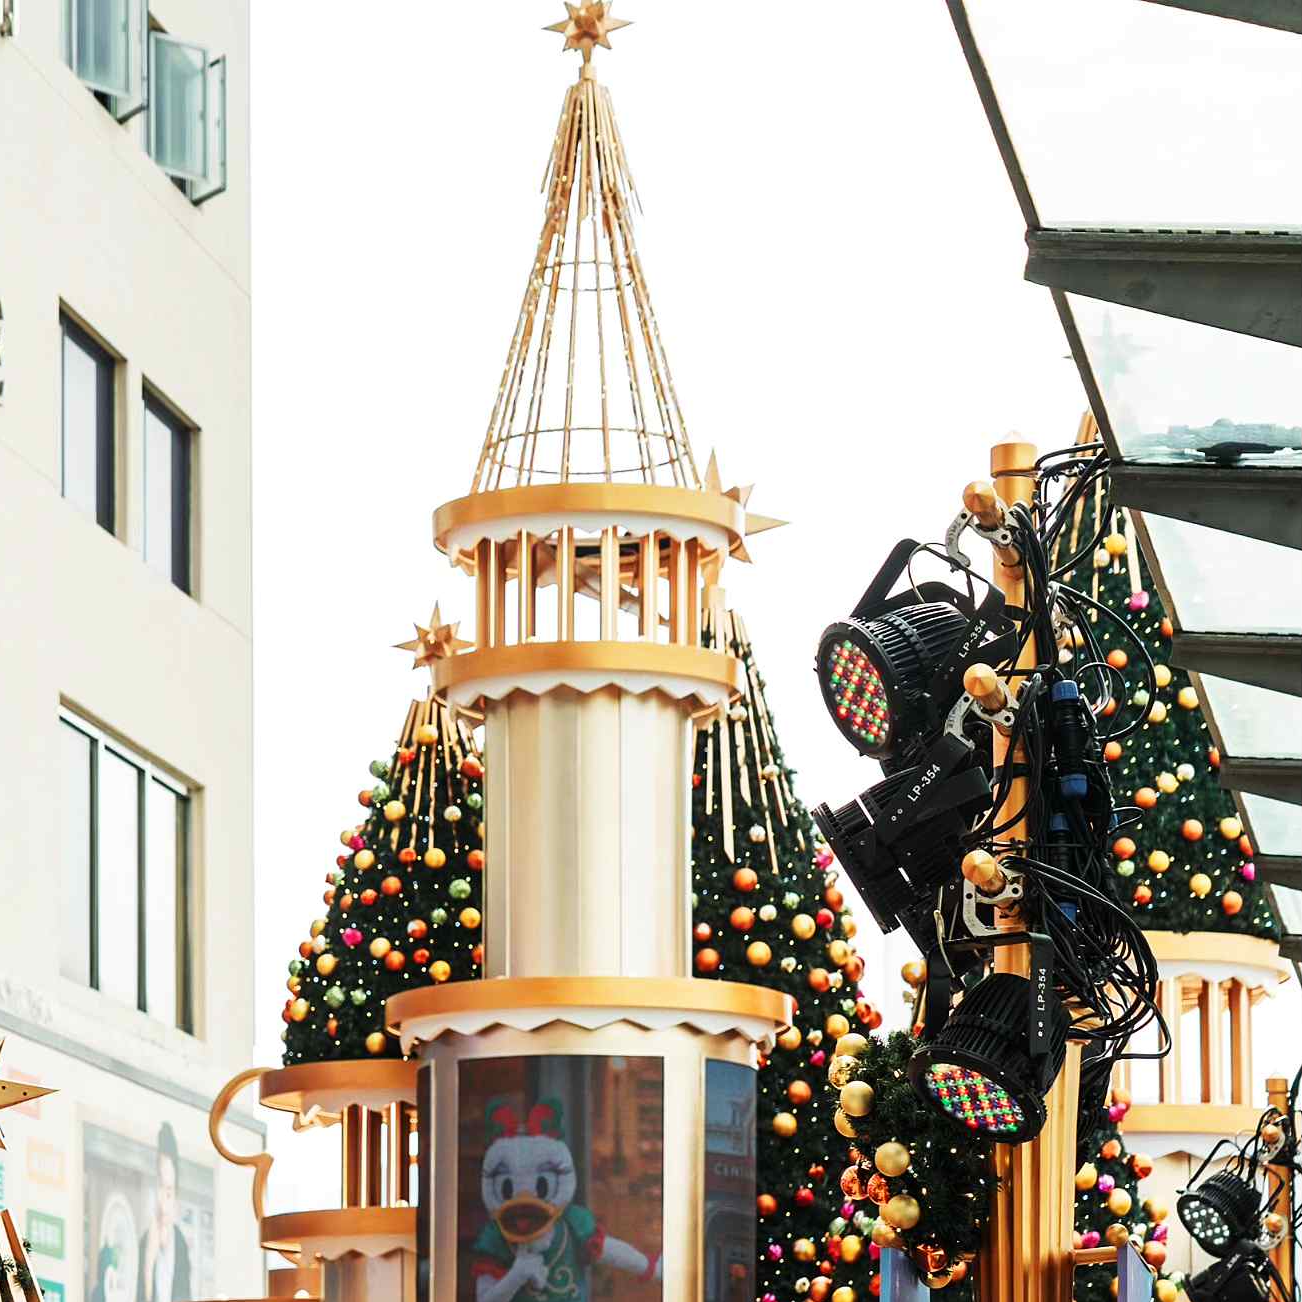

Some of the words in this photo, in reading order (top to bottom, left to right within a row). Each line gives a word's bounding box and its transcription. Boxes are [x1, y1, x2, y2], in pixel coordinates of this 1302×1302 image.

[958, 619, 986, 658] LP-354
[907, 764, 941, 802] LP-354
[1037, 968, 1047, 1011] LP-354
